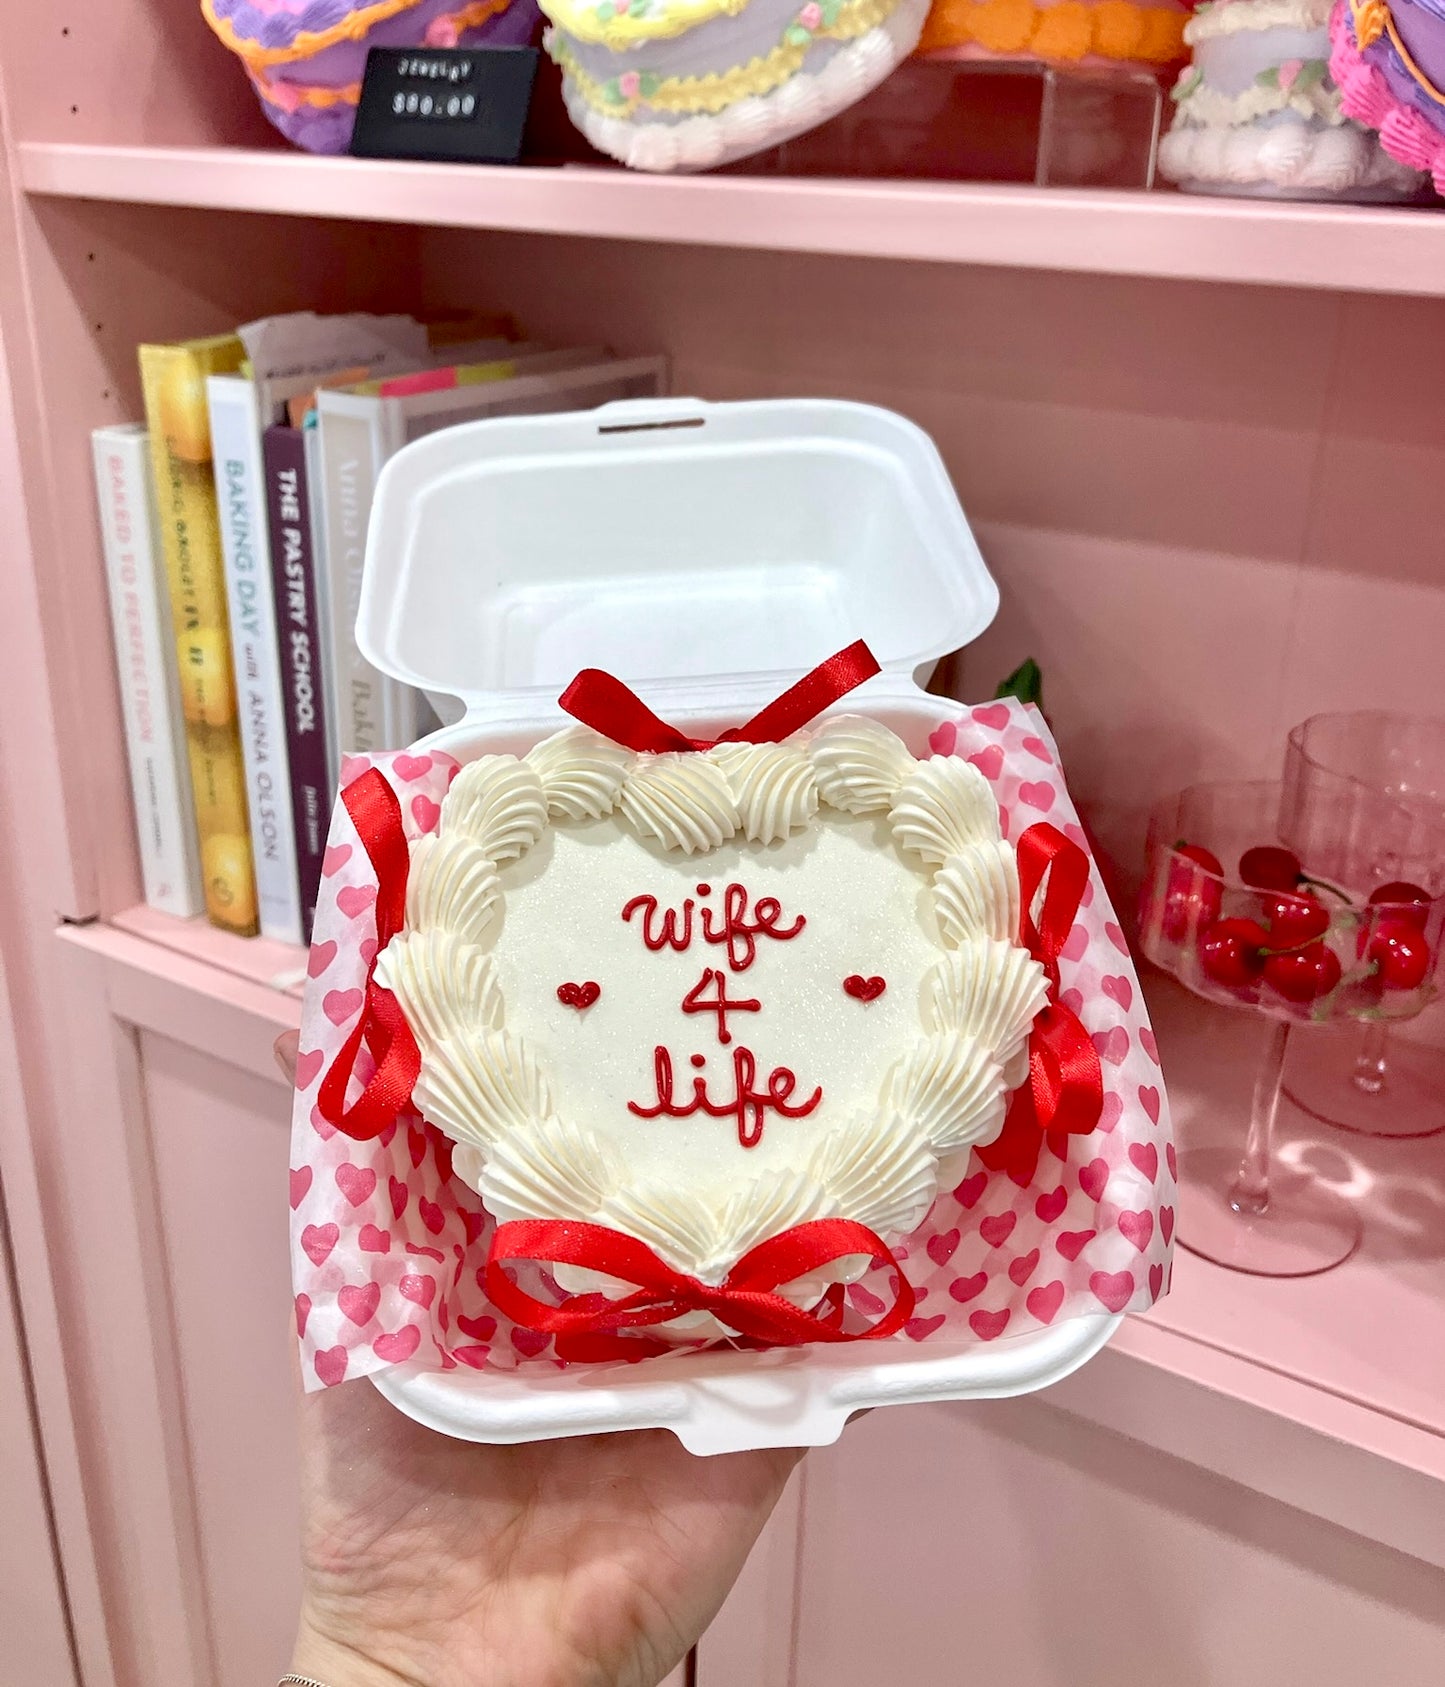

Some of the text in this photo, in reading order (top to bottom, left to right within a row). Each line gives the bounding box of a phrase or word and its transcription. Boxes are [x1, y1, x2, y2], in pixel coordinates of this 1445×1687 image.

[224, 458, 257, 574] BAKING
[120, 554, 137, 586] TO
[236, 578, 262, 638] DAY
[276, 466, 317, 737] THE PASTRY SCHOOL
[247, 689, 270, 764] ANNA
[255, 770, 280, 863] OLSON
[681, 967, 762, 1045] 4
[627, 1045, 823, 1149] life
